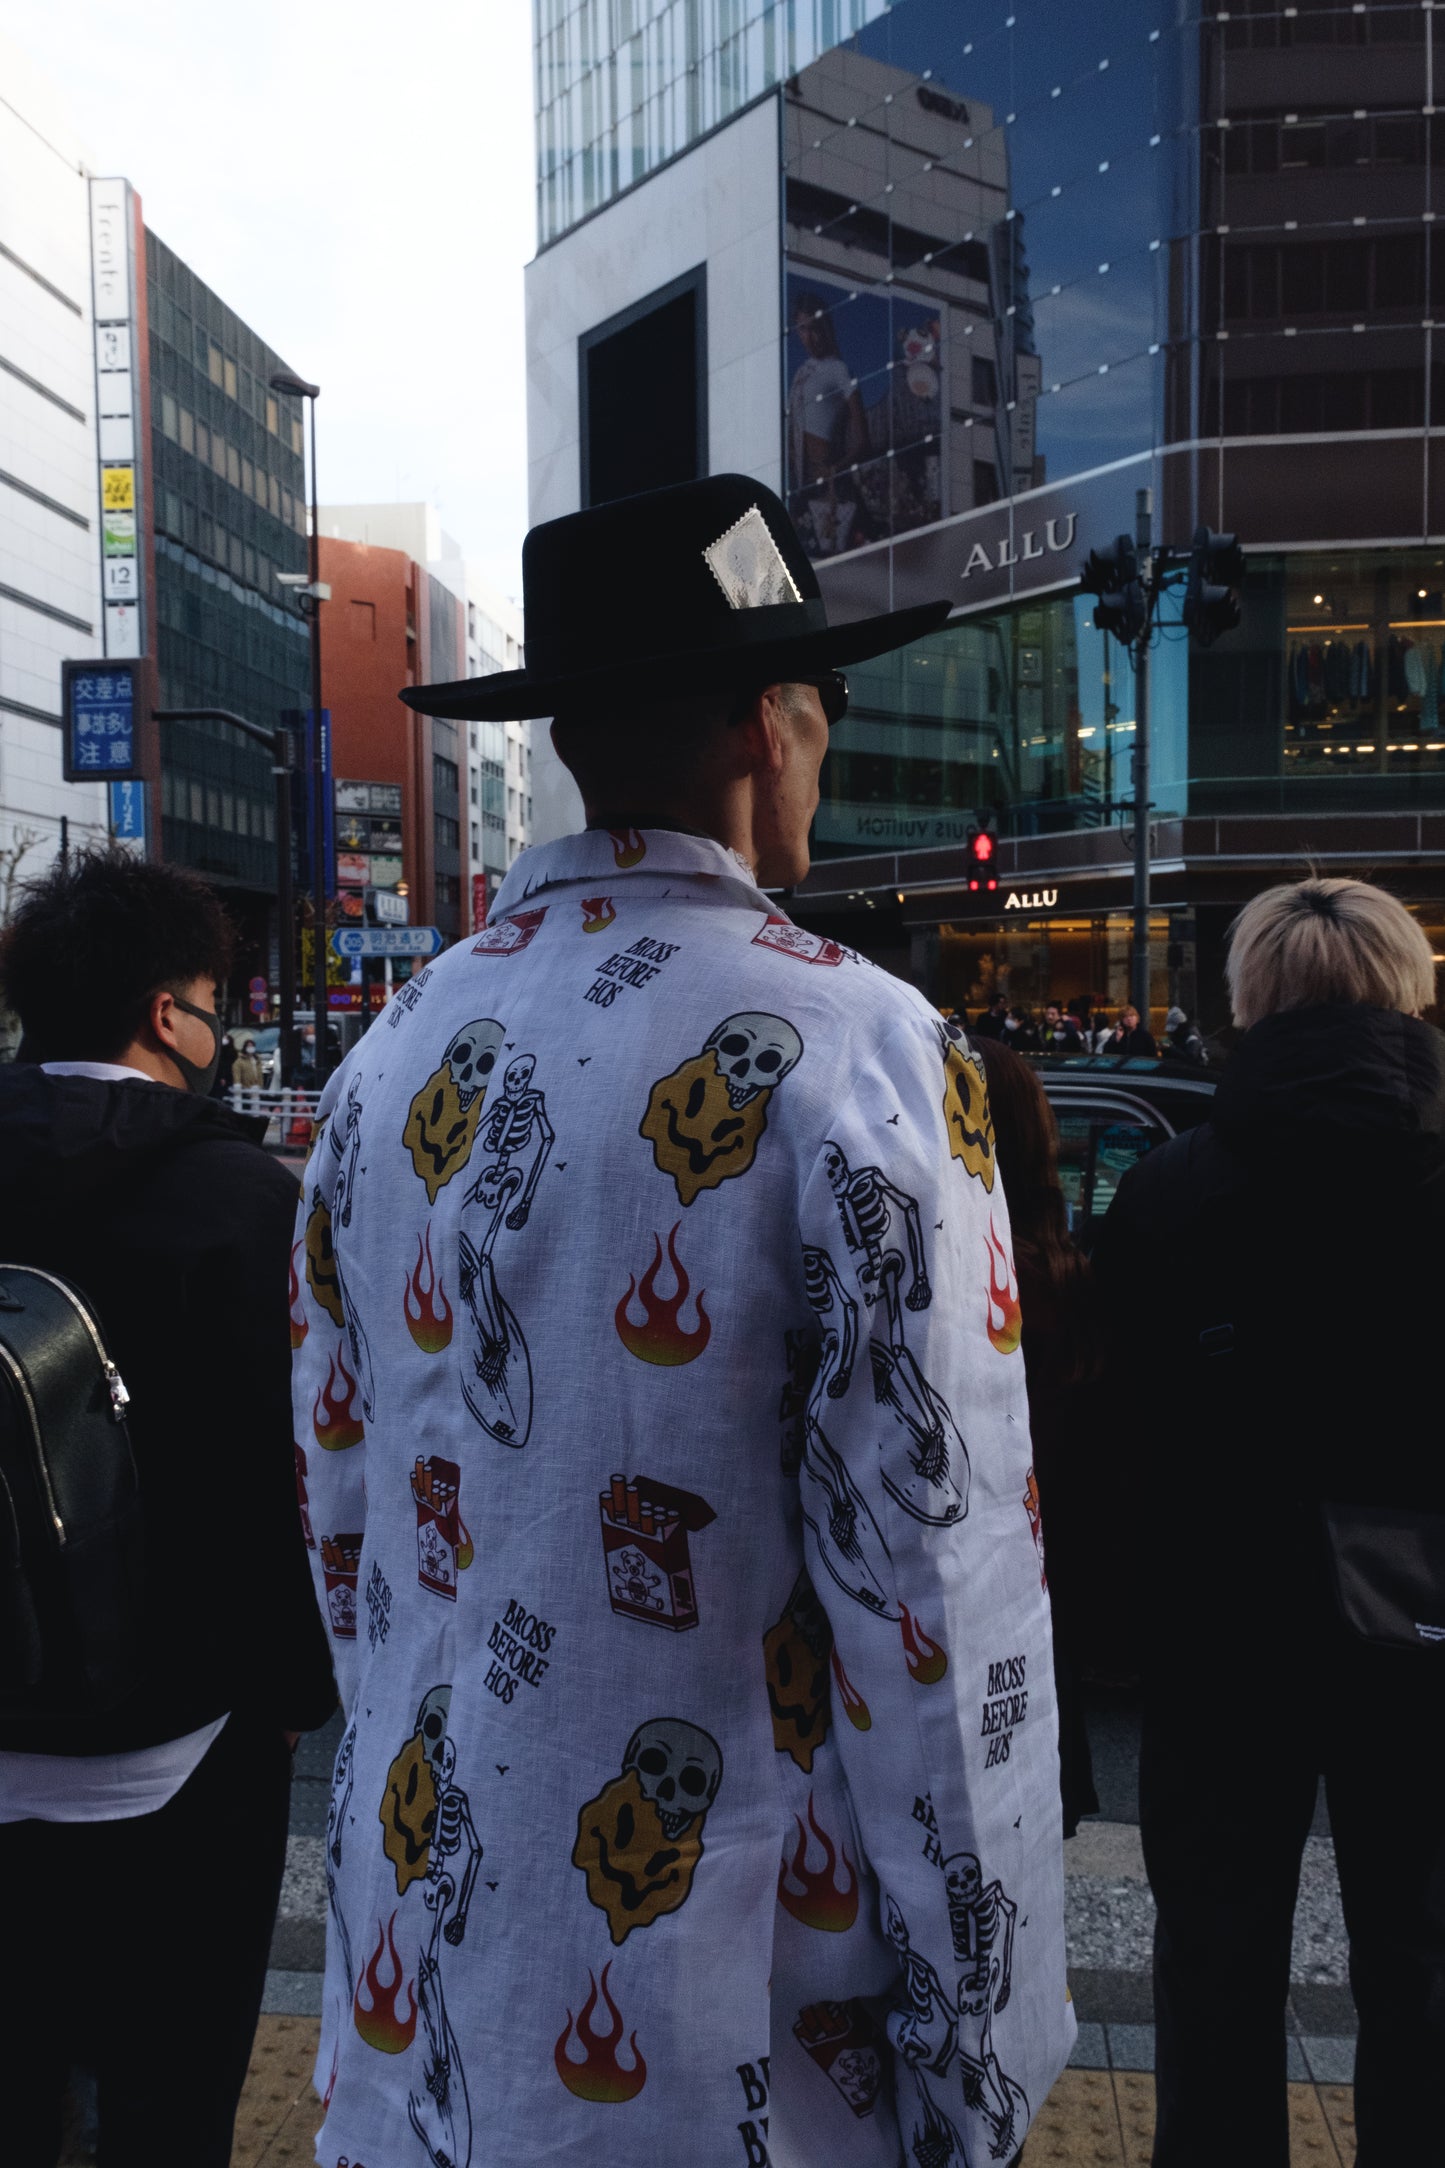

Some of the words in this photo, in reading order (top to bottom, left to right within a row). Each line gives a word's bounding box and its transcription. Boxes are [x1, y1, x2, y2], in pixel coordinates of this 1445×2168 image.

[961, 512, 1077, 579] ALLU
[76, 676, 133, 700] 交差点
[1004, 889, 1058, 910] ALLU
[370, 931, 426, 945] 明治通り
[624, 937, 681, 963] BROSS
[595, 954, 661, 989] BEFORE
[583, 977, 623, 1008] HOS
[502, 1598, 557, 1653] BROSS
[487, 1621, 550, 1688] BEFORE
[483, 1659, 520, 1705] HOS
[987, 1655, 1026, 1697] BROSS
[980, 1690, 1028, 1737] BEFORE
[984, 1731, 1013, 1769] HOS
